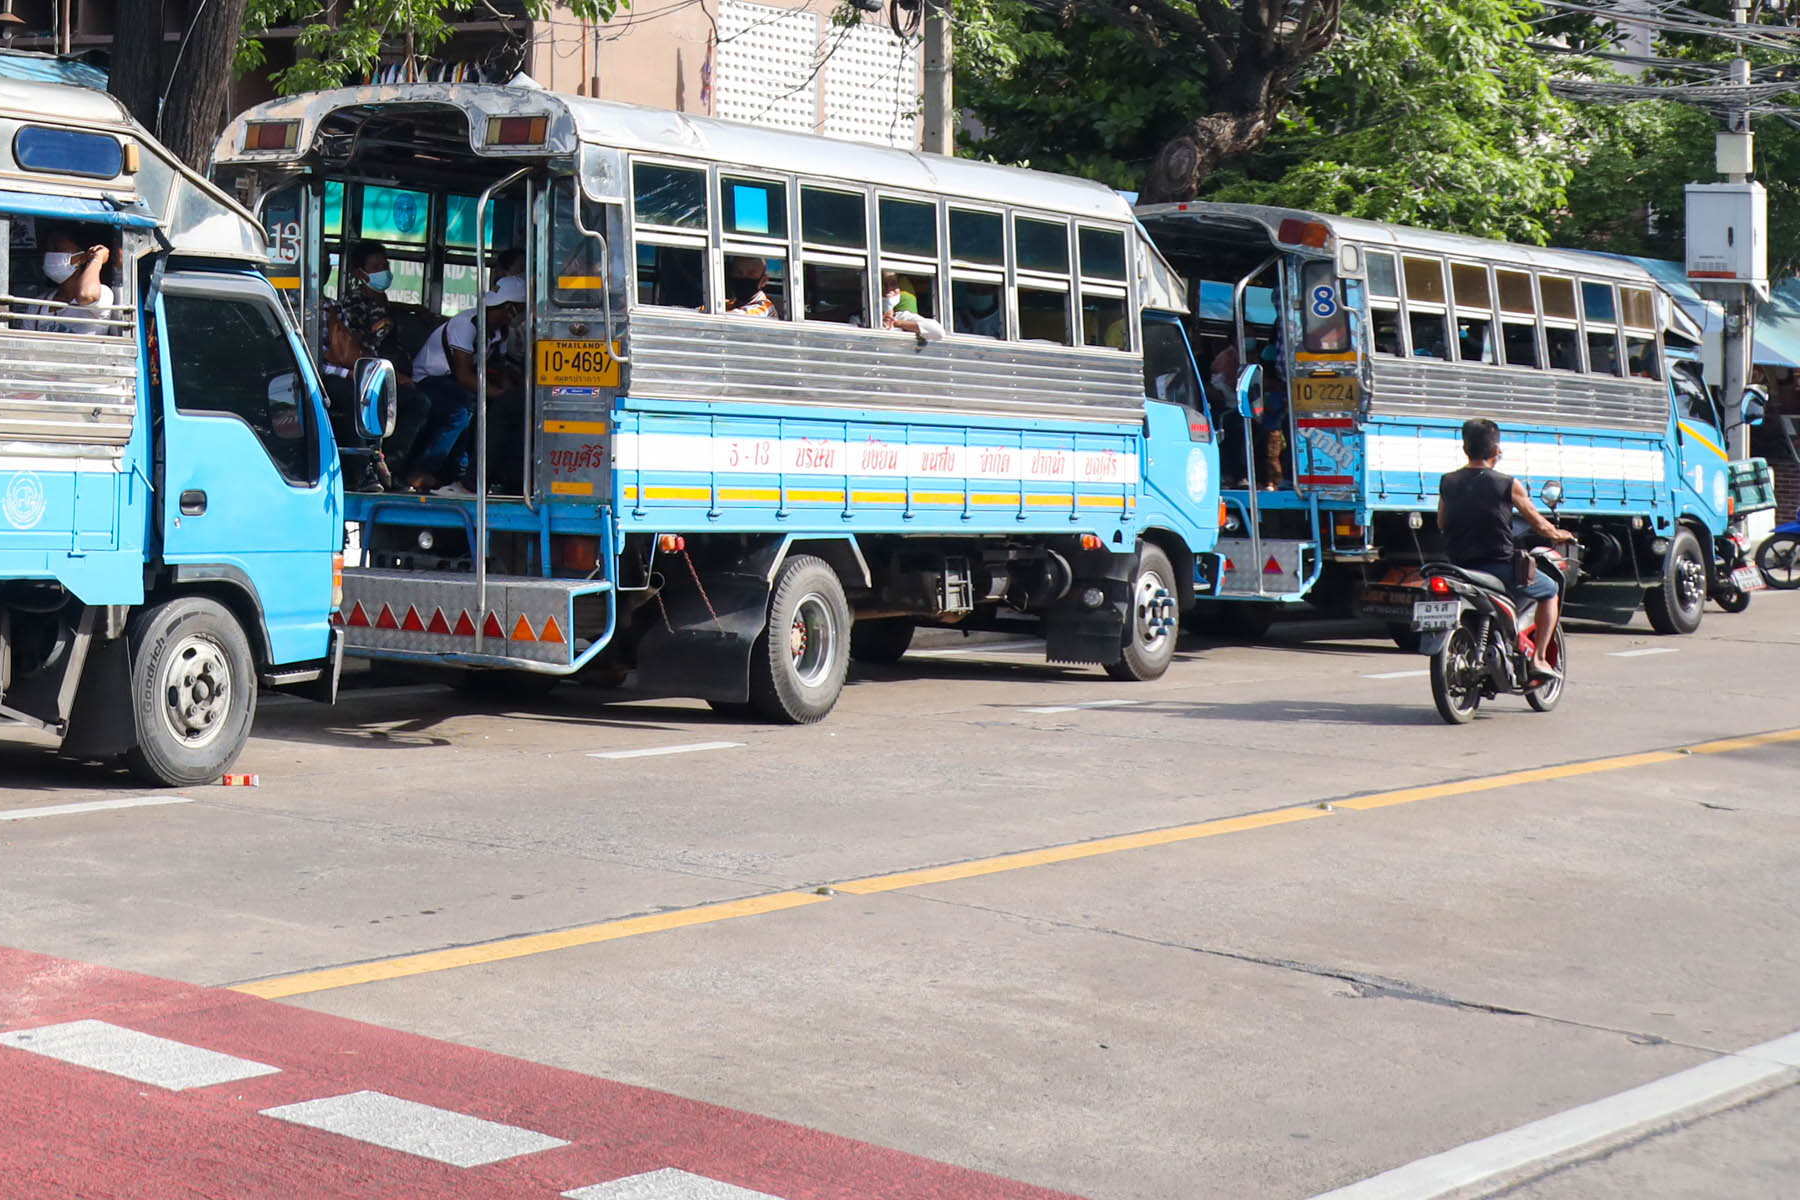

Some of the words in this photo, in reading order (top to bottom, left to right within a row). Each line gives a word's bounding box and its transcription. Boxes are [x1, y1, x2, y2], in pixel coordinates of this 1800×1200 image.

[271, 221, 300, 262] 13
[1312, 284, 1337, 319] 8
[545, 351, 611, 373] 10-4697
